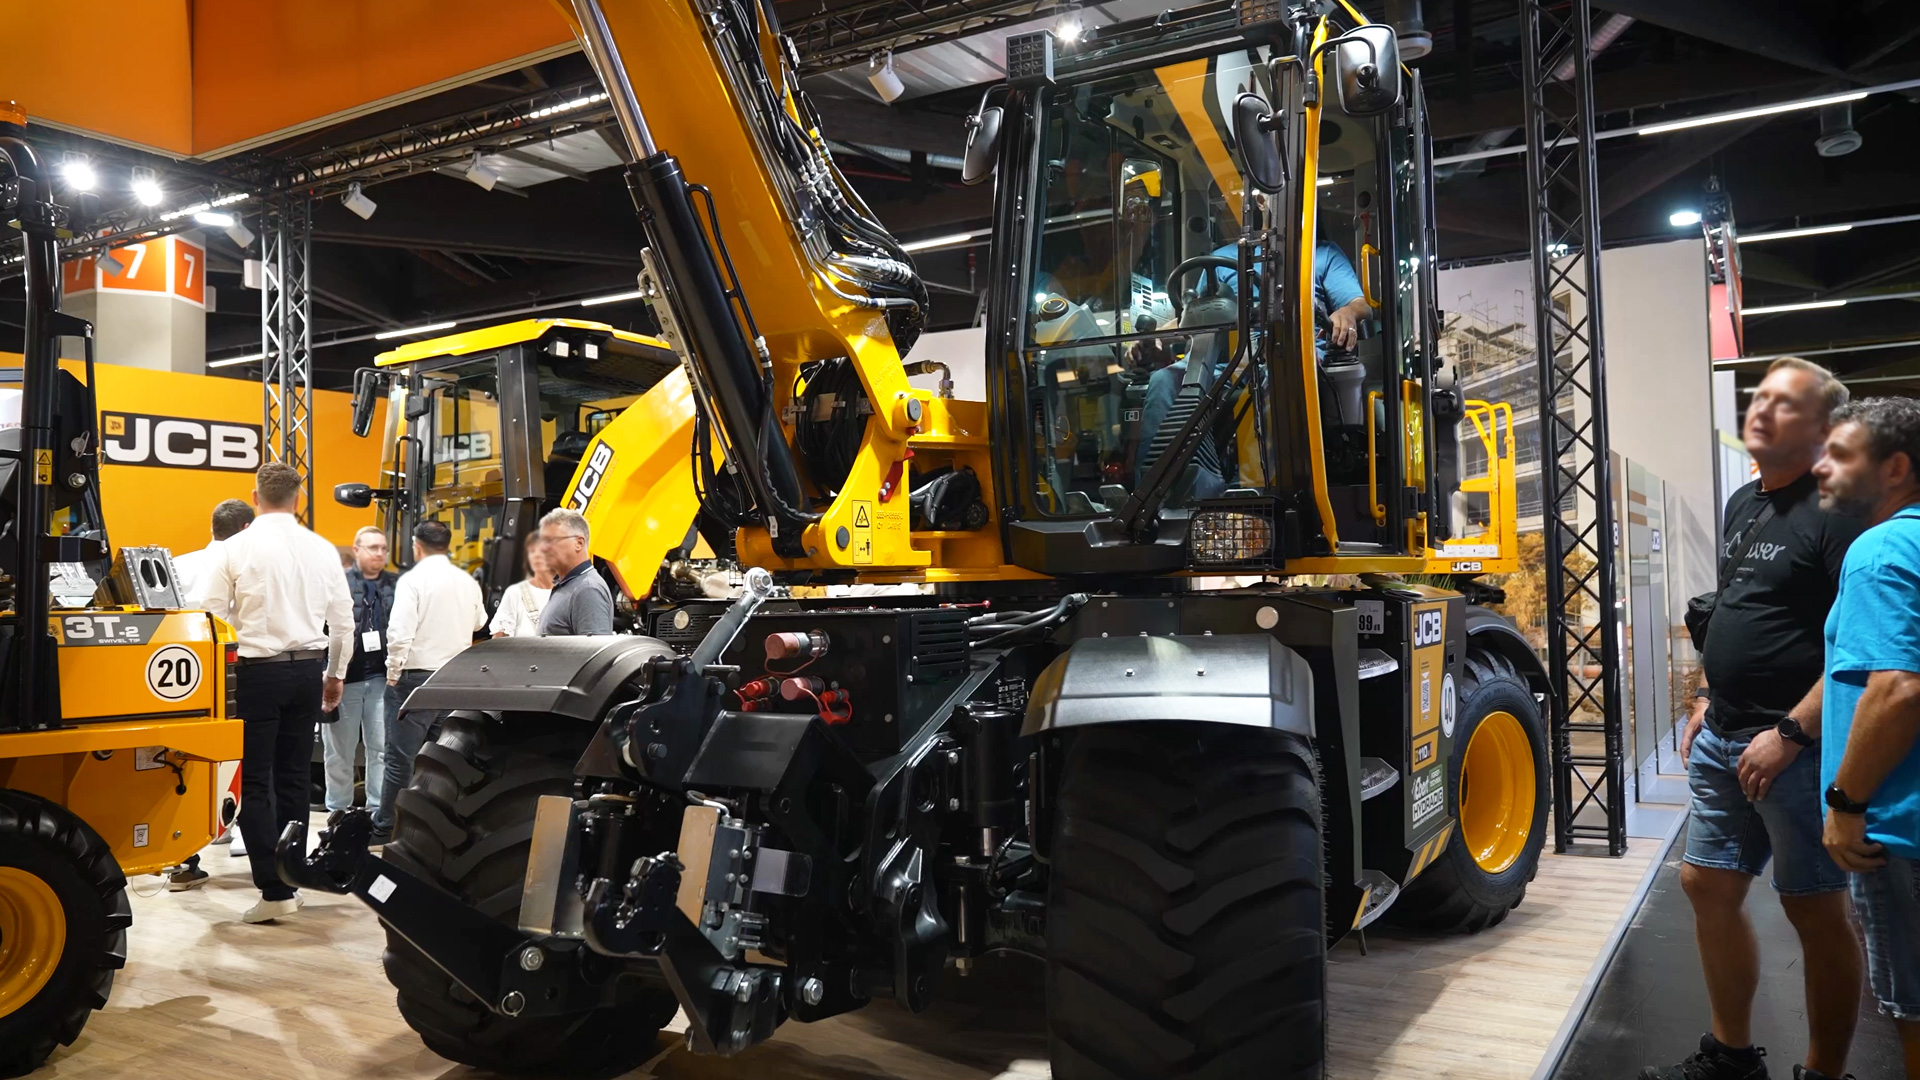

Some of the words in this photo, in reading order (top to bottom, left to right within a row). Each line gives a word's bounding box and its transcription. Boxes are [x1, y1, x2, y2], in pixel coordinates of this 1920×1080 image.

[123, 243, 147, 280] 7
[183, 252, 195, 289] 7
[105, 417, 260, 469] JCB
[434, 433, 492, 462] JCB
[573, 443, 612, 515] JCB
[1451, 561, 1482, 572] JCB
[1358, 614, 1373, 631] 99
[1414, 611, 1442, 647] JCB
[157, 657, 192, 688] 20
[1444, 686, 1453, 725] 40
[1413, 787, 1443, 820] HYDRADIG
